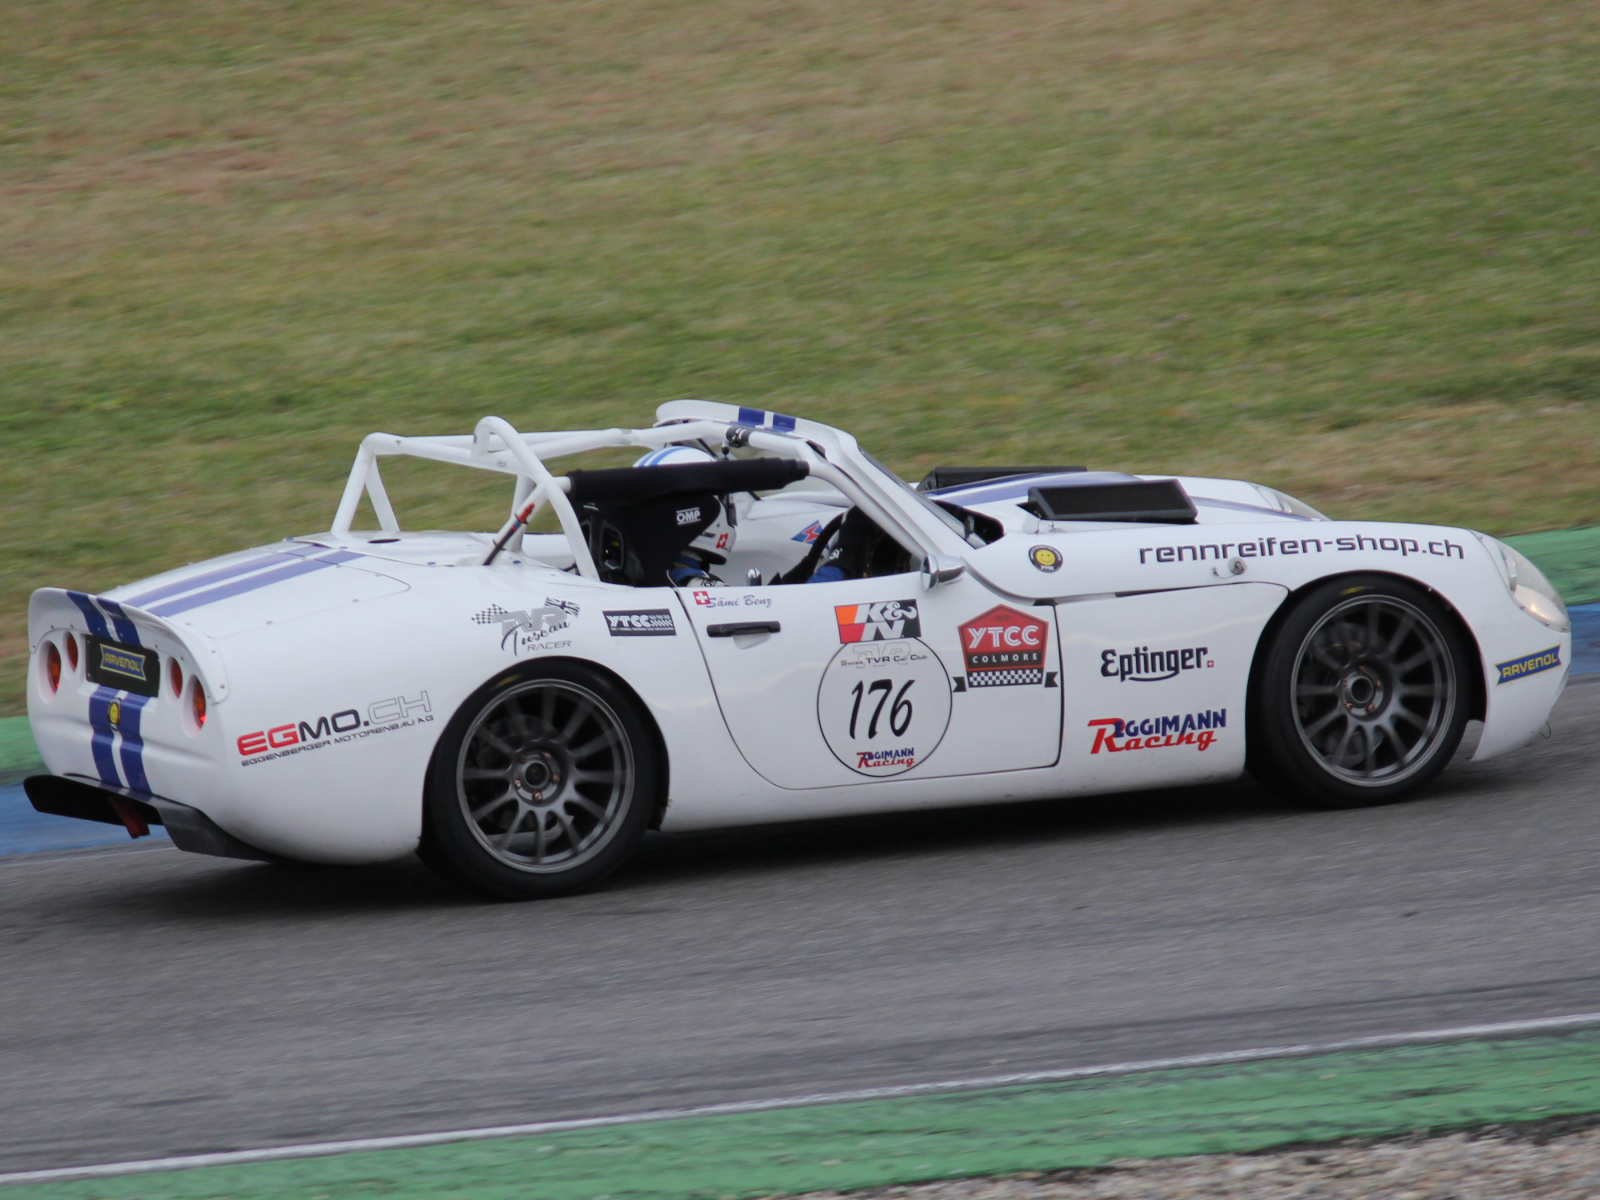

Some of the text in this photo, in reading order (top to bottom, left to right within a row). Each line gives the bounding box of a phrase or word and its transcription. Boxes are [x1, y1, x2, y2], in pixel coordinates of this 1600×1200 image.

[677, 510, 700, 523] OMP
[1139, 534, 1465, 564] rennreifen-shop.ch
[743, 594, 772, 608] Benz
[606, 614, 651, 627] YTCC
[527, 640, 572, 652] RACER
[967, 625, 1040, 649] YTCC
[104, 652, 141, 673] RAVENOL
[866, 656, 890, 664] TVR
[972, 653, 1038, 663] COLMORE
[1100, 646, 1208, 682] Eptinger
[1502, 653, 1558, 678] RAVENOL
[849, 679, 916, 740] 176
[237, 690, 432, 756] EGMO.CH
[1114, 708, 1227, 738] EGGIMANN
[241, 715, 434, 767] EGGENBERGER MOTORENBAU AG
[1087, 718, 1218, 755] Racing
[856, 751, 915, 768] Racing
